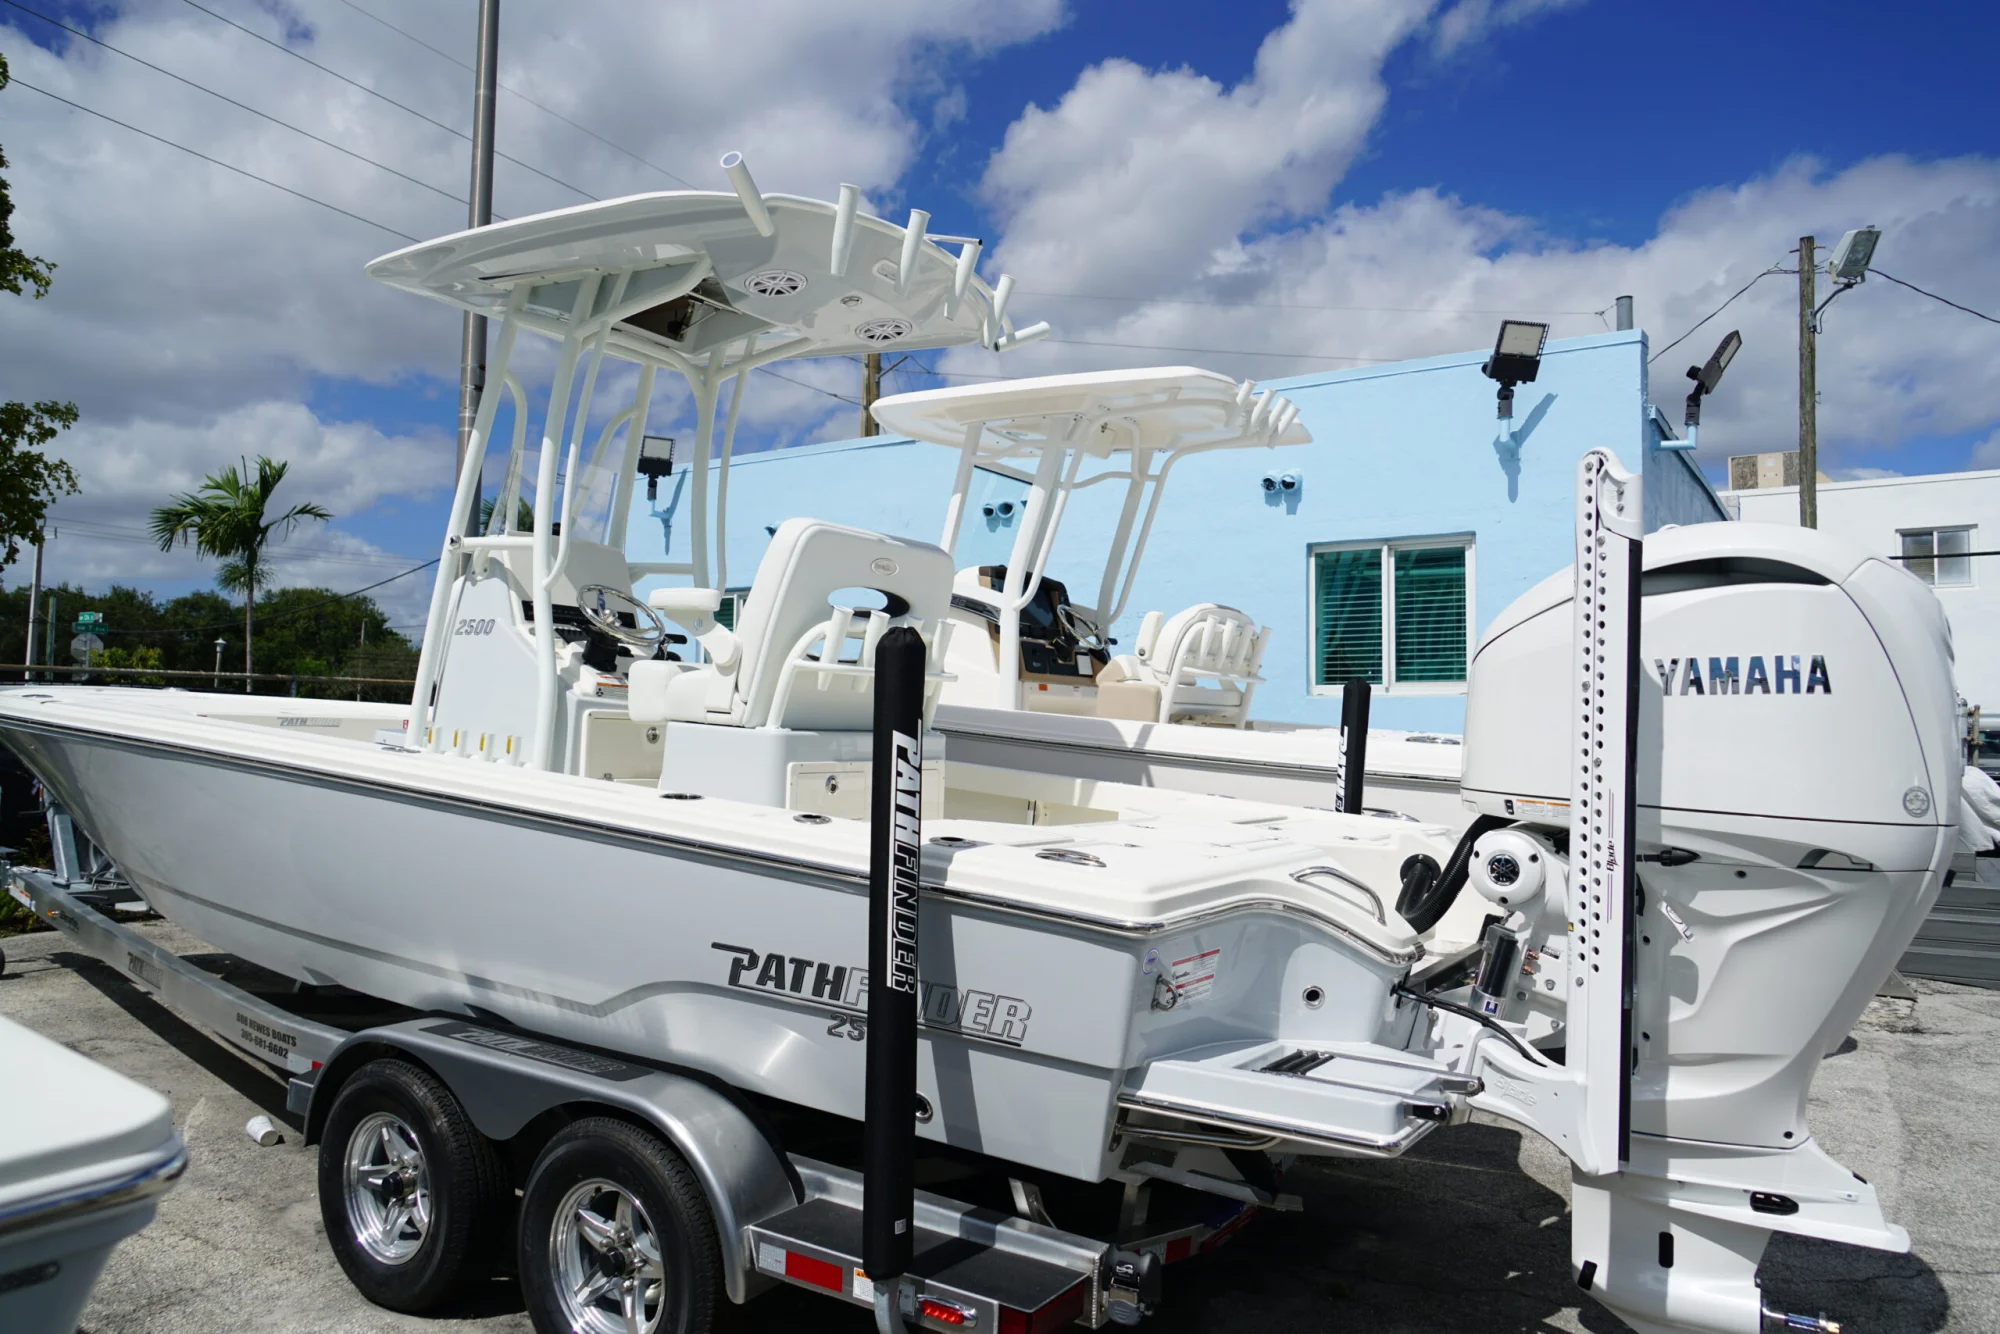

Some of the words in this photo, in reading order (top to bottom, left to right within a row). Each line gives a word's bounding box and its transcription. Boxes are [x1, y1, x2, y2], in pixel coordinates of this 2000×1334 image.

[454, 618, 496, 636] 2500
[1653, 655, 1832, 696] YAMAHA
[886, 718, 922, 995] PATHFINDER
[1606, 840, 1619, 872] Blade
[711, 941, 1032, 1047] PATHFDER
[236, 1012, 249, 1027] BOB
[272, 1028, 297, 1047] BOATS
[826, 1013, 868, 1042] 25
